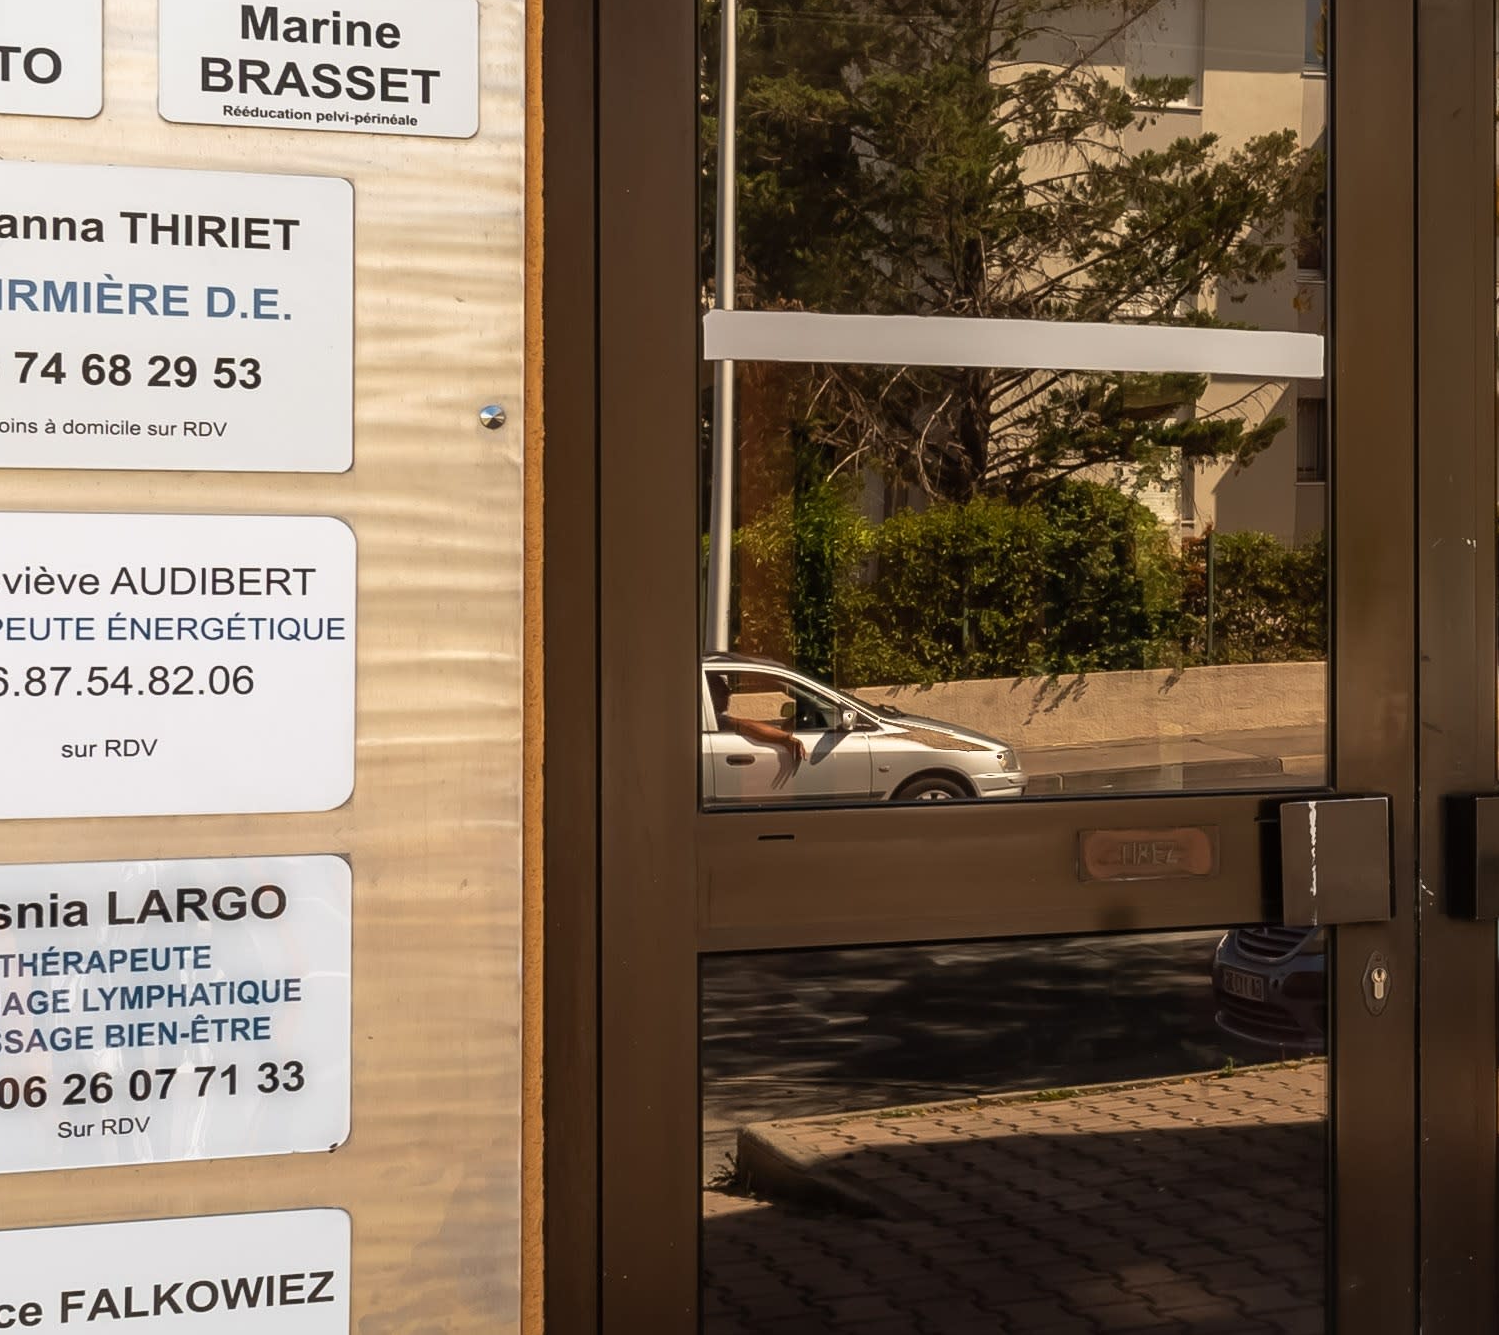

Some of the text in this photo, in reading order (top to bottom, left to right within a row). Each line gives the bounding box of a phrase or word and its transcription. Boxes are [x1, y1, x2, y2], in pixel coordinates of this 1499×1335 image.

[242, 5, 400, 48] Marine
[202, 57, 440, 104] BRASSET
[223, 105, 417, 126] Rééducation pelvi-périnéale
[120, 212, 300, 250] THIRIET
[207, 287, 291, 320] D.E.
[15, 352, 66, 384] 74
[82, 354, 131, 386] 68
[148, 356, 197, 387] 29
[214, 358, 261, 389] 53
[45, 419, 55, 434] à
[63, 420, 141, 435] domicile
[148, 425, 177, 436] sur
[184, 422, 227, 436] RDV
[110, 567, 316, 595] AUDIBERT
[108, 612, 345, 641] ÉNERGÉTIQUE
[62, 739, 157, 758] sur RDV
[108, 885, 286, 925] LARGO
[83, 978, 301, 1012] LYMPHATIQUE
[106, 1014, 270, 1047] BIEN-ÊTRE
[63, 1072, 113, 1105] 26
[129, 1068, 176, 1101] 07
[195, 1064, 236, 1097] 71
[258, 1061, 304, 1093] 33
[58, 1117, 150, 1138] Sur RDV
[61, 1271, 334, 1323] FALKOWIEZ
